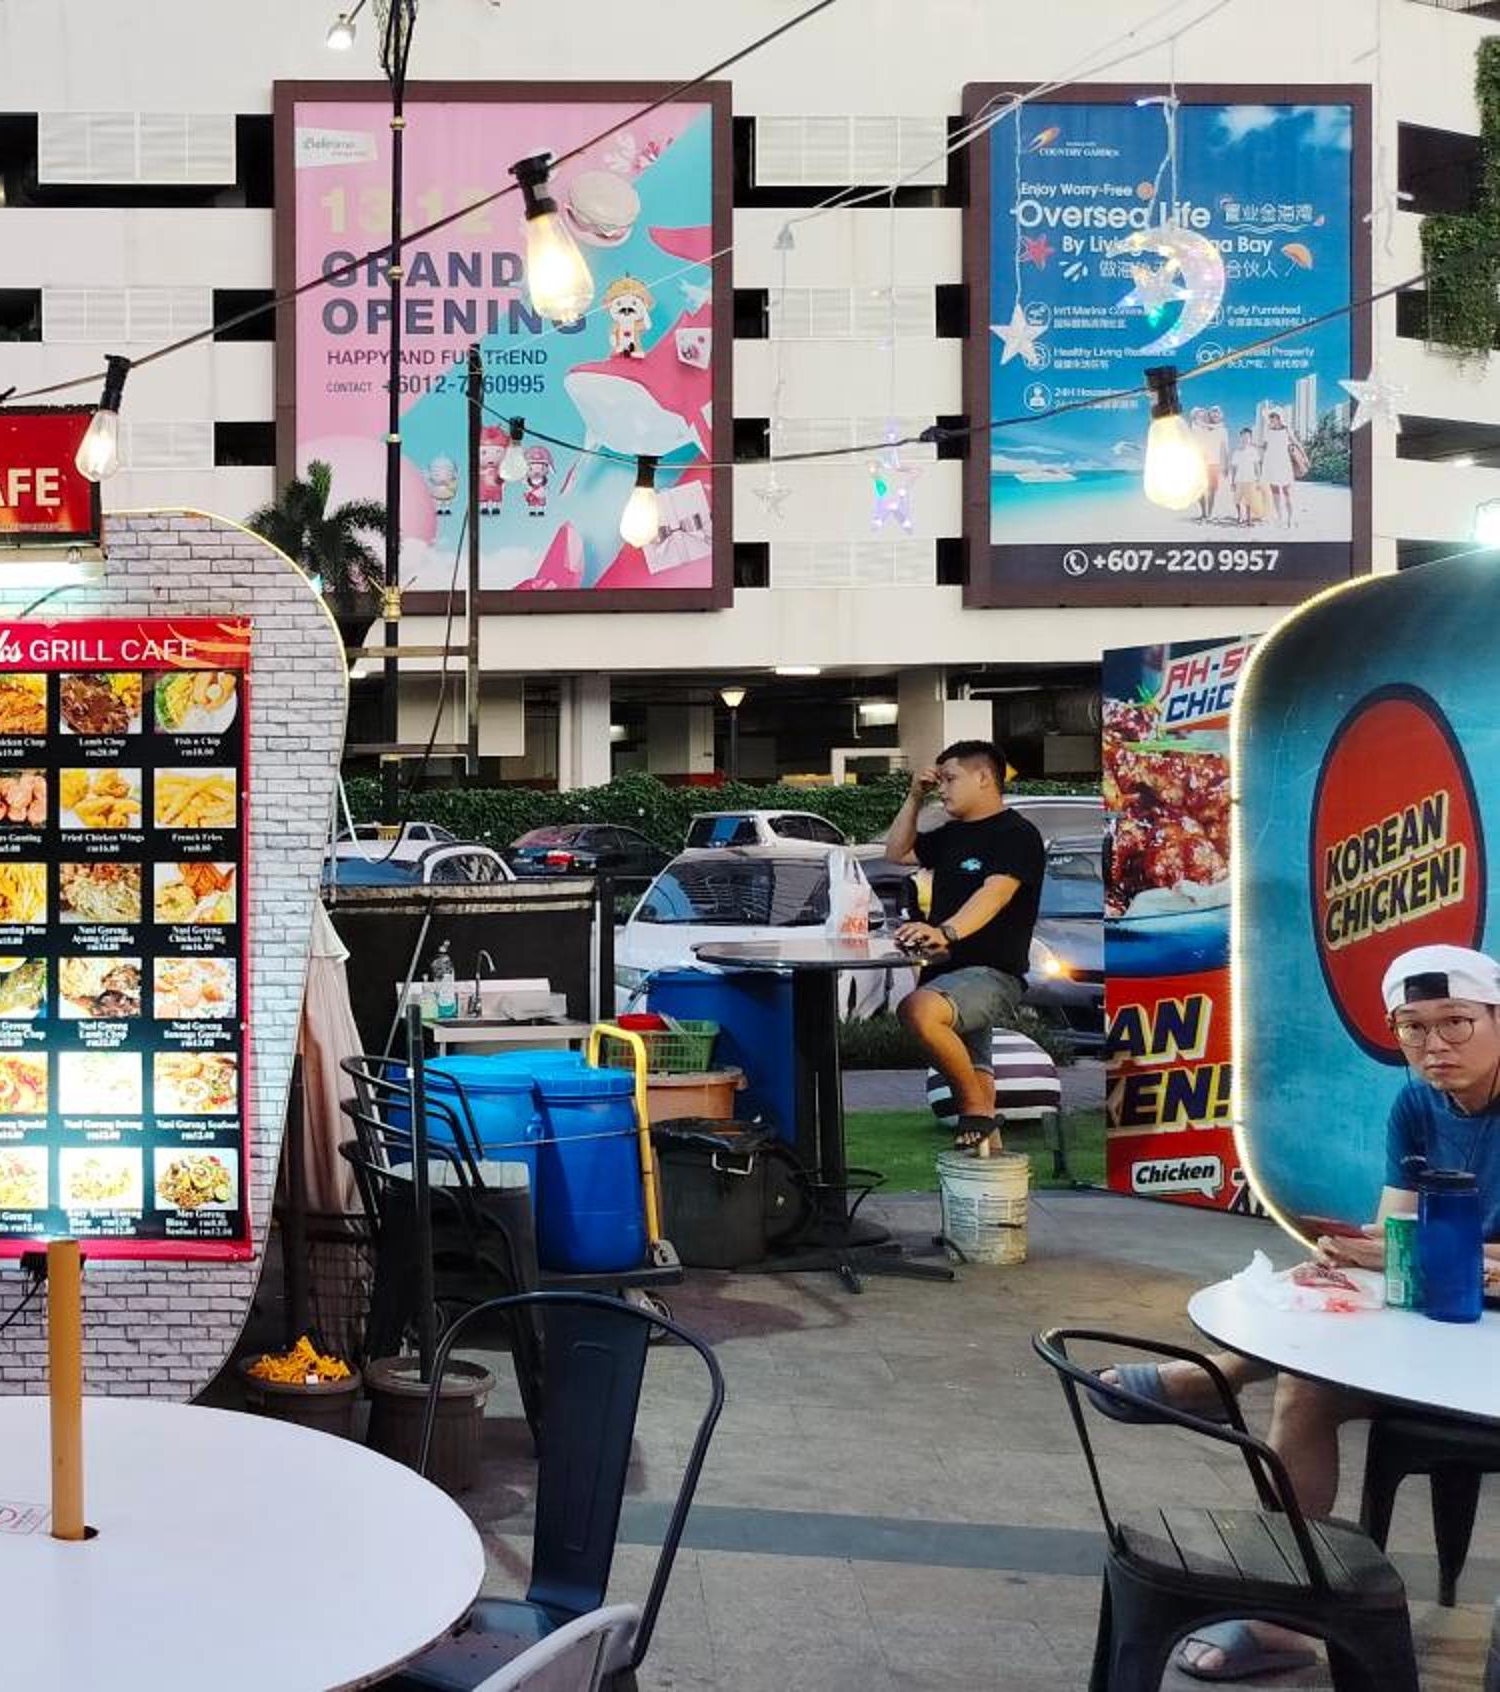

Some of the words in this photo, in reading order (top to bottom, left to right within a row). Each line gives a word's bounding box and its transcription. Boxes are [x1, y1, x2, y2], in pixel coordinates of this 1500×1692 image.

[1021, 182, 1056, 199] Enjoy
[1060, 182, 1132, 198] Worry-Free
[1160, 201, 1210, 229] Life
[1063, 236, 1084, 253] By
[1238, 236, 1272, 255] Bay
[321, 250, 526, 288] GRAND
[327, 351, 390, 365] HAPPY
[398, 351, 436, 365] AND
[441, 350, 482, 365] FU
[486, 350, 548, 365] TREND
[326, 382, 372, 393] CONTACT
[382, 375, 545, 393] +6012-760995
[1093, 550, 1214, 571] +607-220
[1218, 550, 1279, 571] 9957
[29, 640, 114, 661] GRILL
[120, 639, 197, 661] CAFE
[1160, 645, 1252, 702] AH-S
[24, 739, 46, 747] Chop
[79, 738, 102, 746] Lamb
[104, 738, 126, 746] Chop
[175, 738, 190, 746] Fish
[62, 834, 82, 842] Fried
[85, 834, 118, 842] Chicken
[119, 834, 144, 842] Wings
[1326, 794, 1447, 889] KOREAN
[1325, 846, 1463, 945] CHICKEN!
[26, 927, 46, 935] Plate
[78, 927, 97, 935] Nasi
[100, 927, 128, 935] Goreng
[169, 935, 202, 944] Chicken
[204, 935, 225, 944] Wing
[172, 927, 190, 935] Nasi
[192, 927, 222, 935] Goreng
[1136, 1162, 1215, 1184] Chicken
